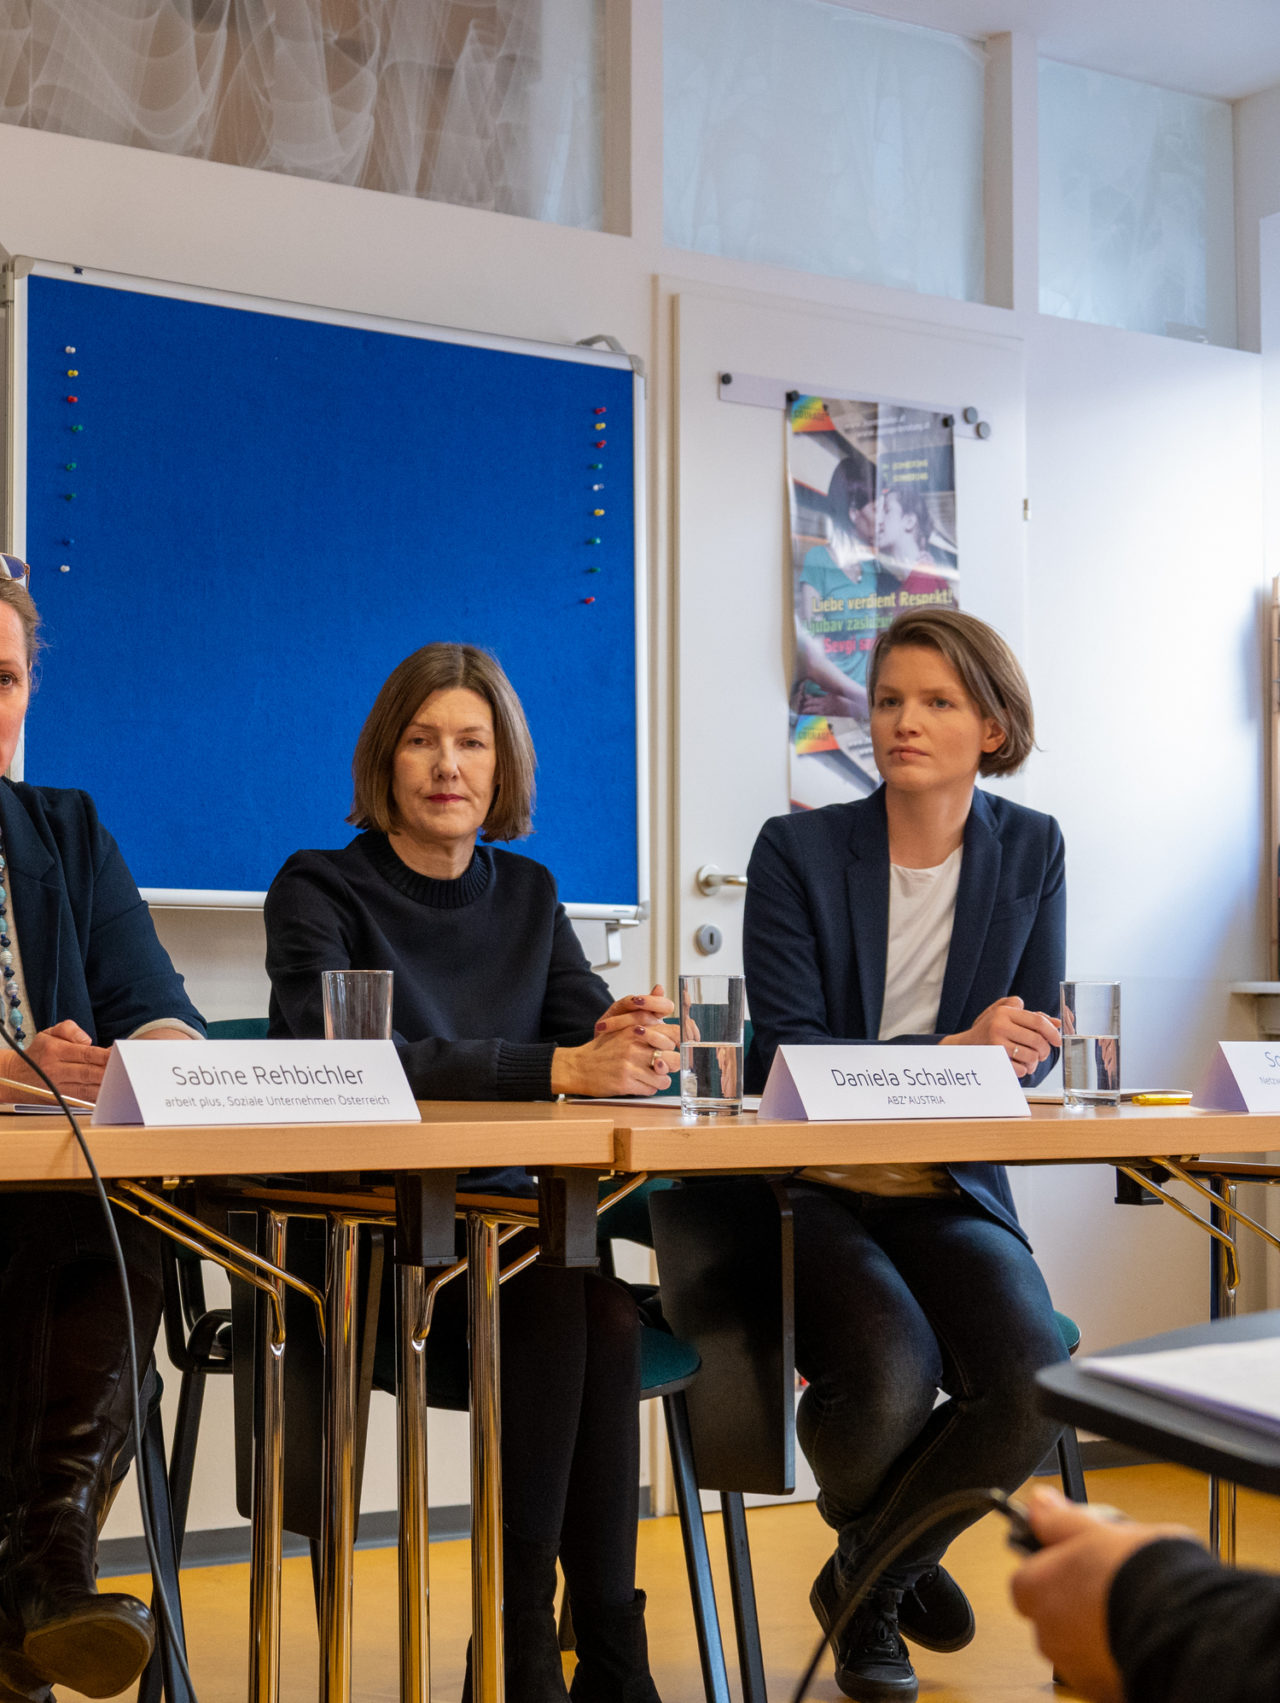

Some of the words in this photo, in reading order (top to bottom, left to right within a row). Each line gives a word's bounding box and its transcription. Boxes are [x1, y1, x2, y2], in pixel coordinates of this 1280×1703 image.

[812, 597, 844, 613] Liebe
[847, 592, 897, 610] verdient
[899, 588, 953, 607] Respekt!
[824, 637, 857, 655] Sevgi
[172, 1065, 248, 1086] Sabine
[252, 1065, 364, 1085] Rehbichler
[831, 1068, 900, 1086] Daniela
[903, 1068, 982, 1086] Schallert
[165, 1096, 196, 1108] arbeit
[200, 1096, 225, 1109] plus,
[228, 1096, 264, 1107] Soziale
[266, 1095, 336, 1107] Unternehmen
[338, 1094, 390, 1106] Österreich
